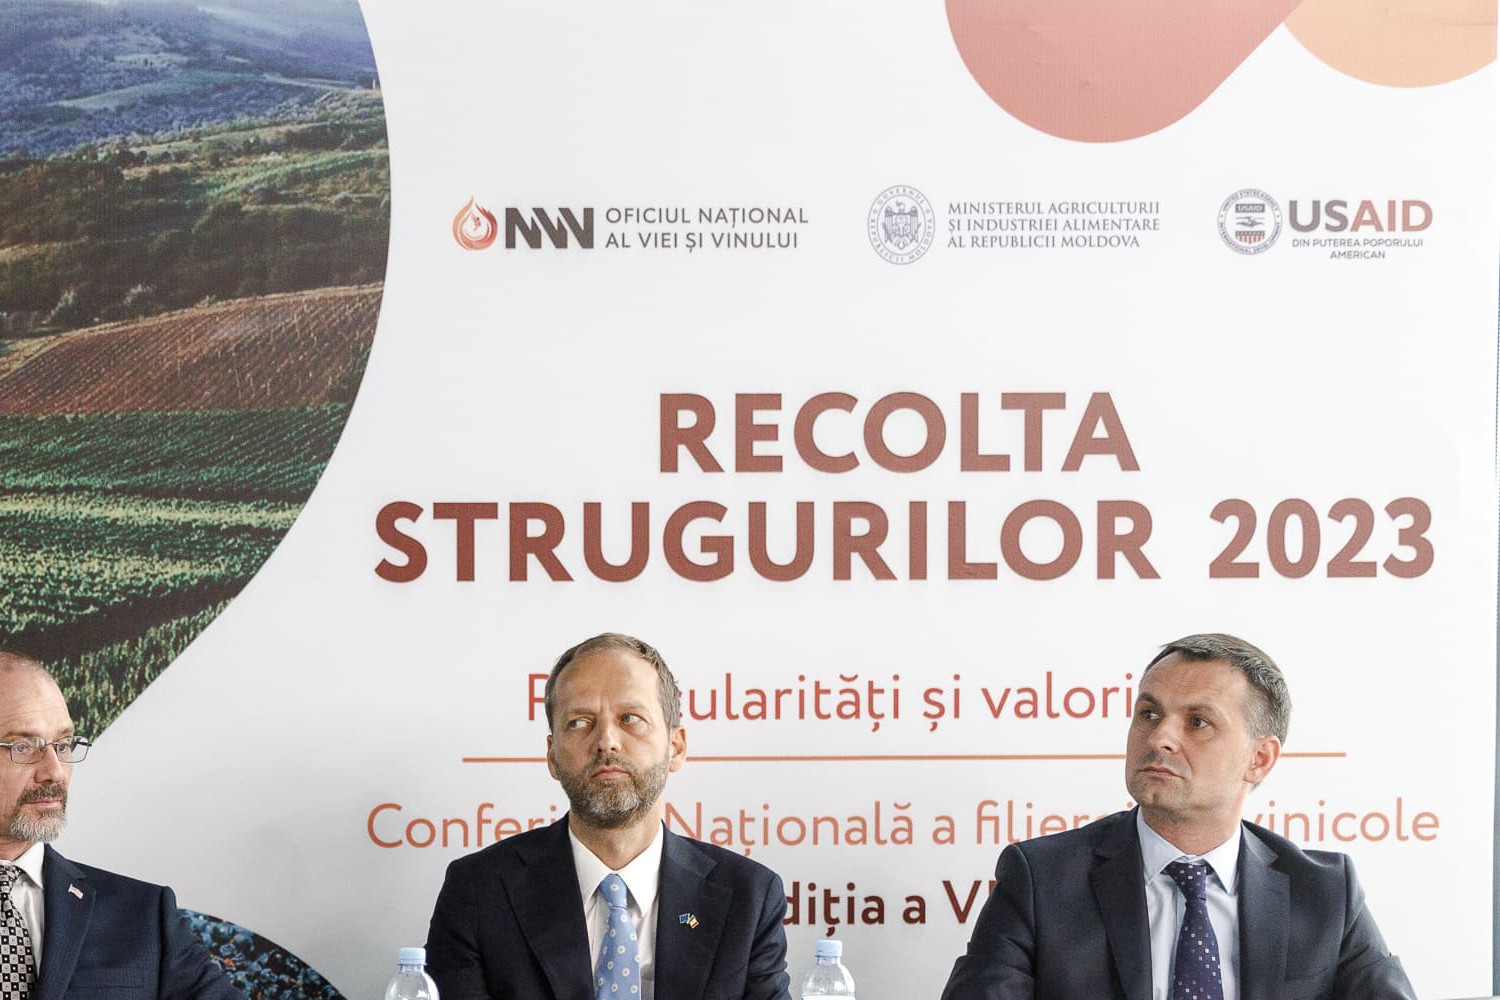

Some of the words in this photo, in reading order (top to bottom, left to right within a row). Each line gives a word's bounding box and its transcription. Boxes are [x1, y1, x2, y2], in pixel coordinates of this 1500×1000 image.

[605, 207, 691, 225] OFICIUL
[698, 207, 809, 228] NAȚIONAL
[948, 201, 1044, 215] MINISTERUL
[1048, 201, 1160, 214] AGRICULTURII
[1289, 199, 1433, 232] USAID
[948, 218, 961, 234] ȘI
[967, 218, 1058, 232] INDUSTRIEI
[1062, 218, 1160, 231] ALIMENTARE
[605, 232, 631, 249] AL
[638, 232, 678, 249] VIEI
[685, 231, 702, 253] ȘI
[711, 232, 798, 249] VINULUI
[947, 235, 966, 248] AL
[971, 235, 1056, 248] REPUBLICII
[1060, 235, 1140, 248] MOLDOVA
[1292, 238, 1310, 247] DIN
[1313, 238, 1360, 247] PUTEREA
[1363, 238, 1423, 247] POPORULUI
[1330, 250, 1386, 259] AMERICAN
[659, 392, 1140, 473] RECOLTA
[374, 499, 1161, 583] STRUGURILOR
[1208, 496, 1435, 580] 2023
[922, 674, 961, 732] și
[981, 671, 1133, 719] valori
[367, 802, 557, 848] Conferi
[664, 801, 914, 856] Națională
[932, 815, 956, 845] a
[1251, 797, 1440, 842] inicole
[783, 881, 885, 937] diția
[902, 894, 926, 925] a
